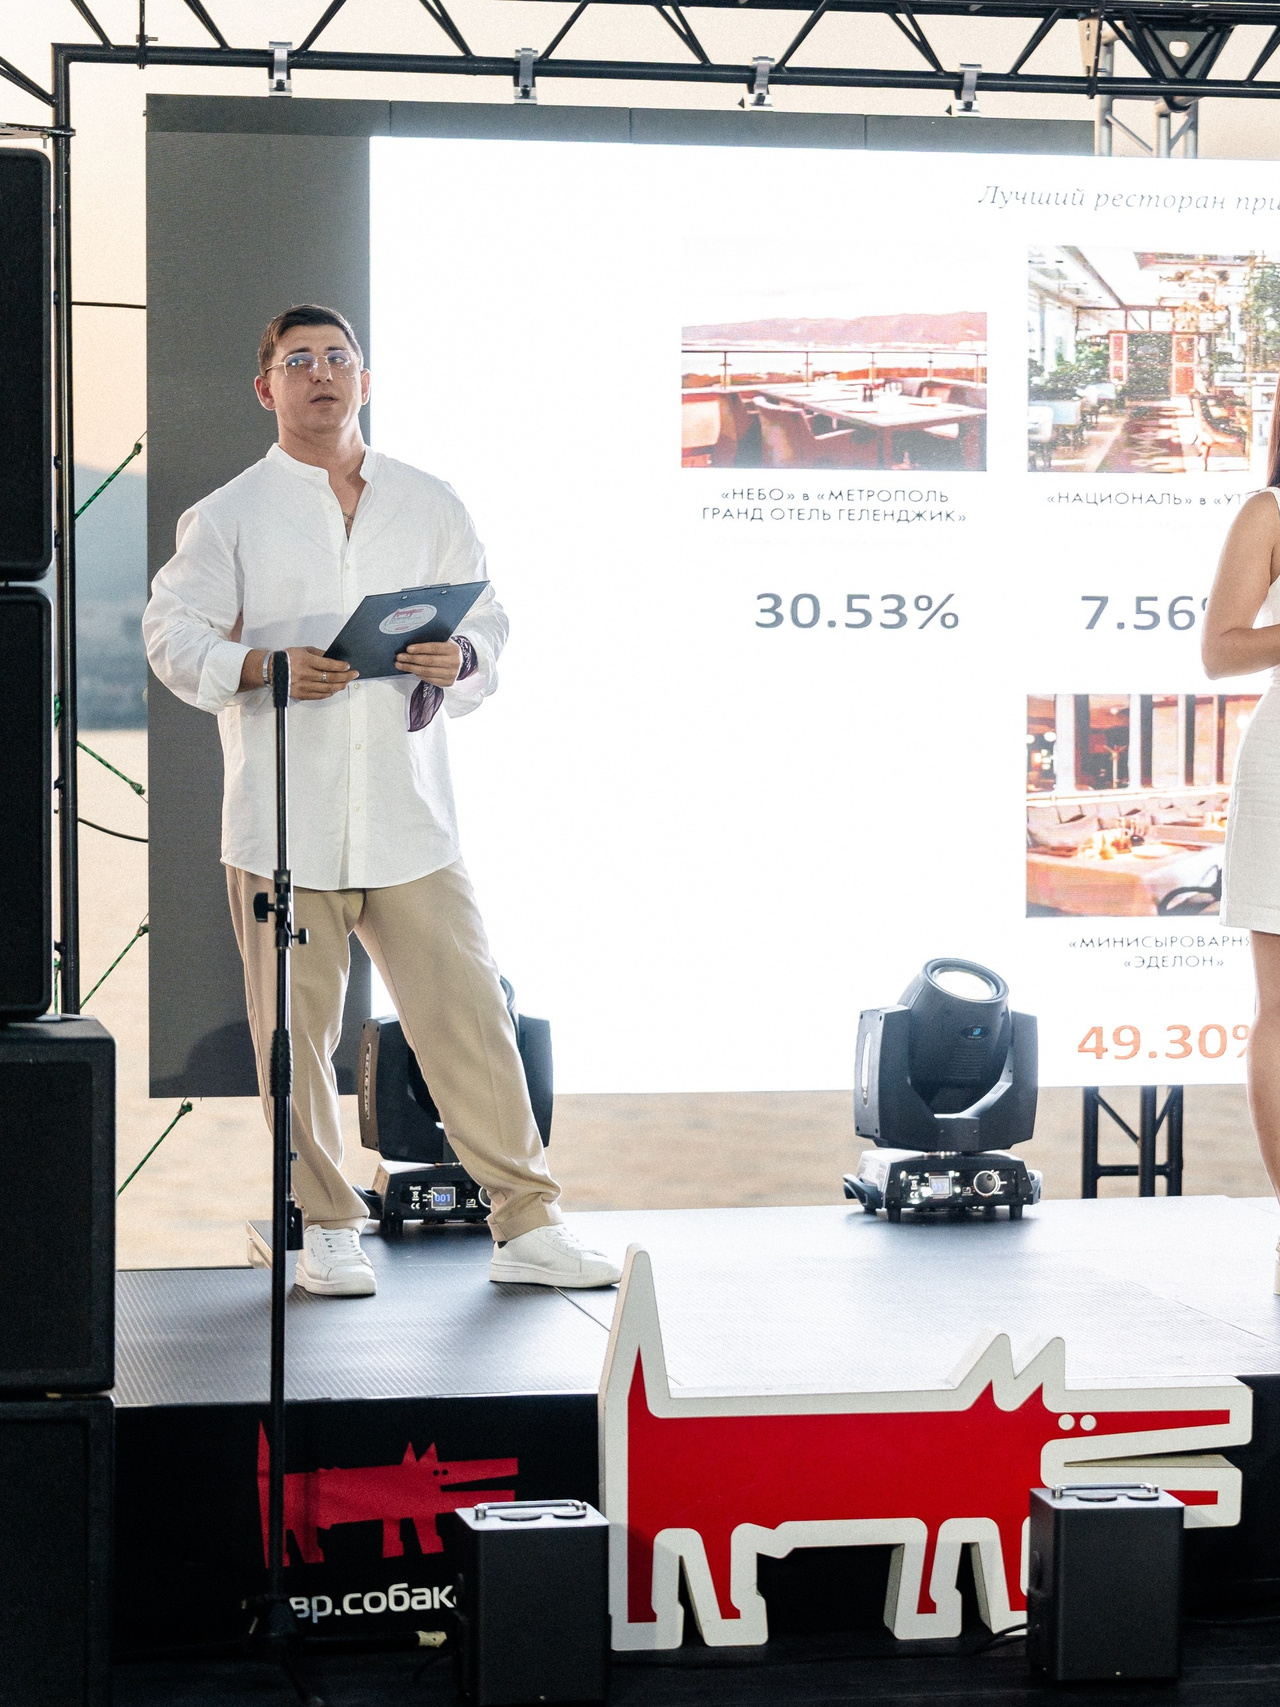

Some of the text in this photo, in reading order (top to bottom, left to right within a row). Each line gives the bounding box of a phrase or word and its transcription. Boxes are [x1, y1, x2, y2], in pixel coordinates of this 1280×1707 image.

[977, 185, 1085, 210] Лучший
[1093, 193, 1226, 214] ресторан
[720, 487, 949, 503] «НЕБО» в «МЕТРОПОЛЬ
[1046, 491, 1193, 507] «НАЦИОНАЛЬ»
[702, 506, 967, 525] ГРАНД ОТЕЛЬ ГЕЛЕНДЖИК»
[754, 592, 960, 630] 30.53%
[1081, 595, 1207, 631] 7.56
[1123, 955, 1224, 970] «ЭДЕЛОН»
[434, 1194, 451, 1202] 001
[289, 1582, 457, 1624] вр.собак
